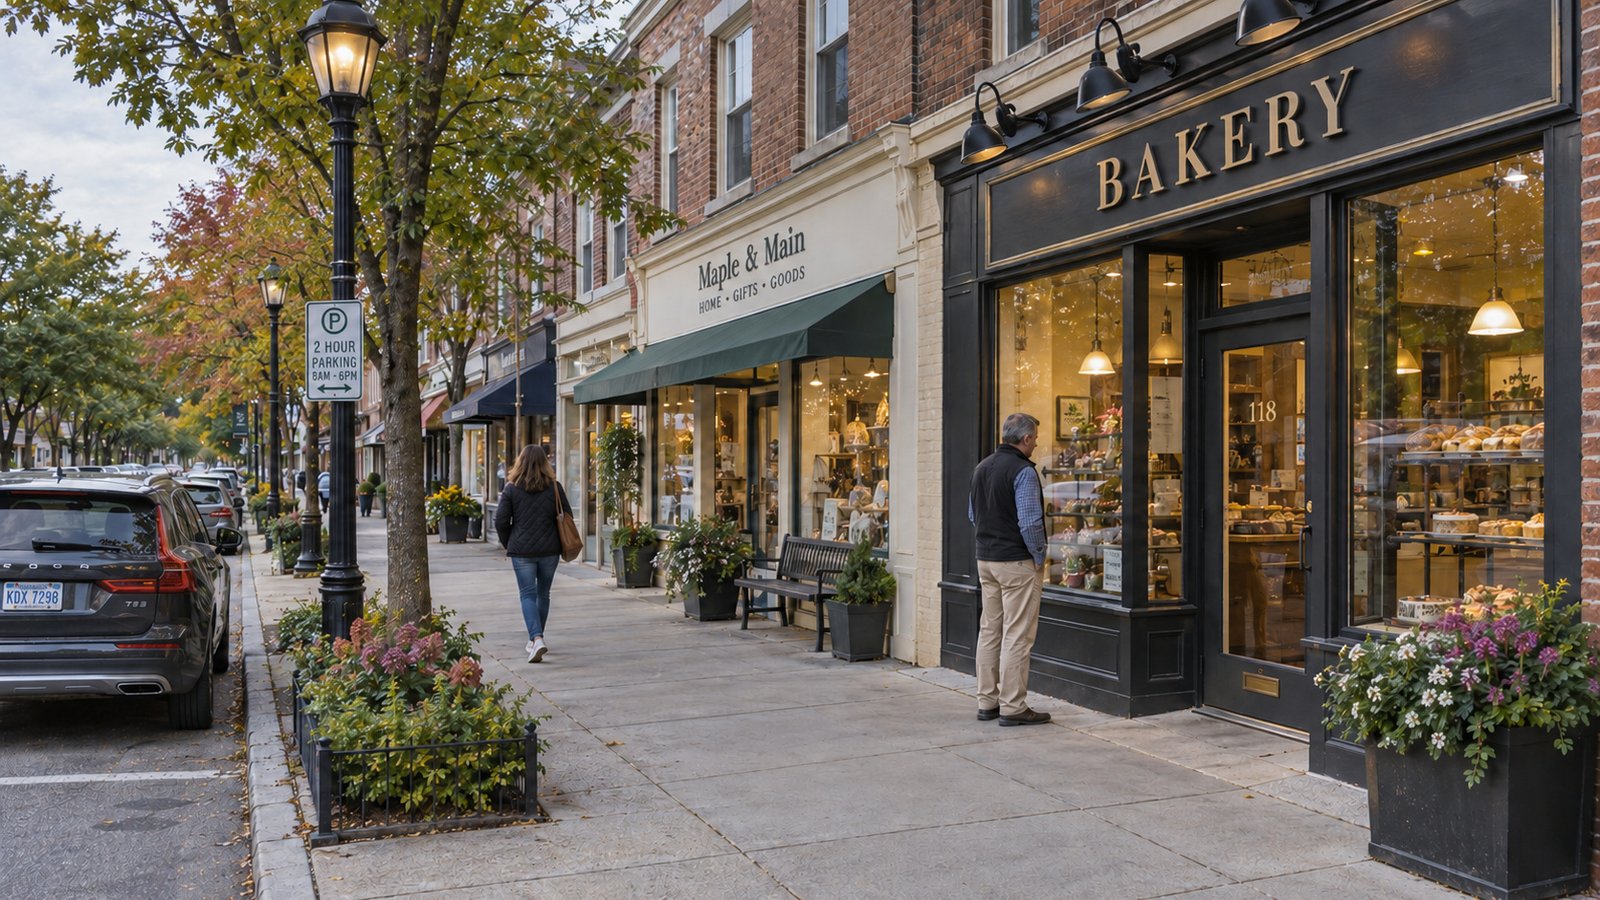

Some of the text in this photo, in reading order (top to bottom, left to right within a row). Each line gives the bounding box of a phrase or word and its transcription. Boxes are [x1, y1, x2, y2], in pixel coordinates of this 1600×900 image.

[1097, 66, 1355, 211] BAKERY
[698, 226, 805, 291] Maple & Main
[698, 265, 805, 314] HOME GIFTS GOODS
[329, 312, 341, 330] P
[314, 341, 356, 353] 2 HOUR
[312, 357, 357, 369] PARKING
[312, 371, 331, 381] 8AM
[1249, 400, 1277, 422] 118
[6, 590, 59, 605] KDX 7298
